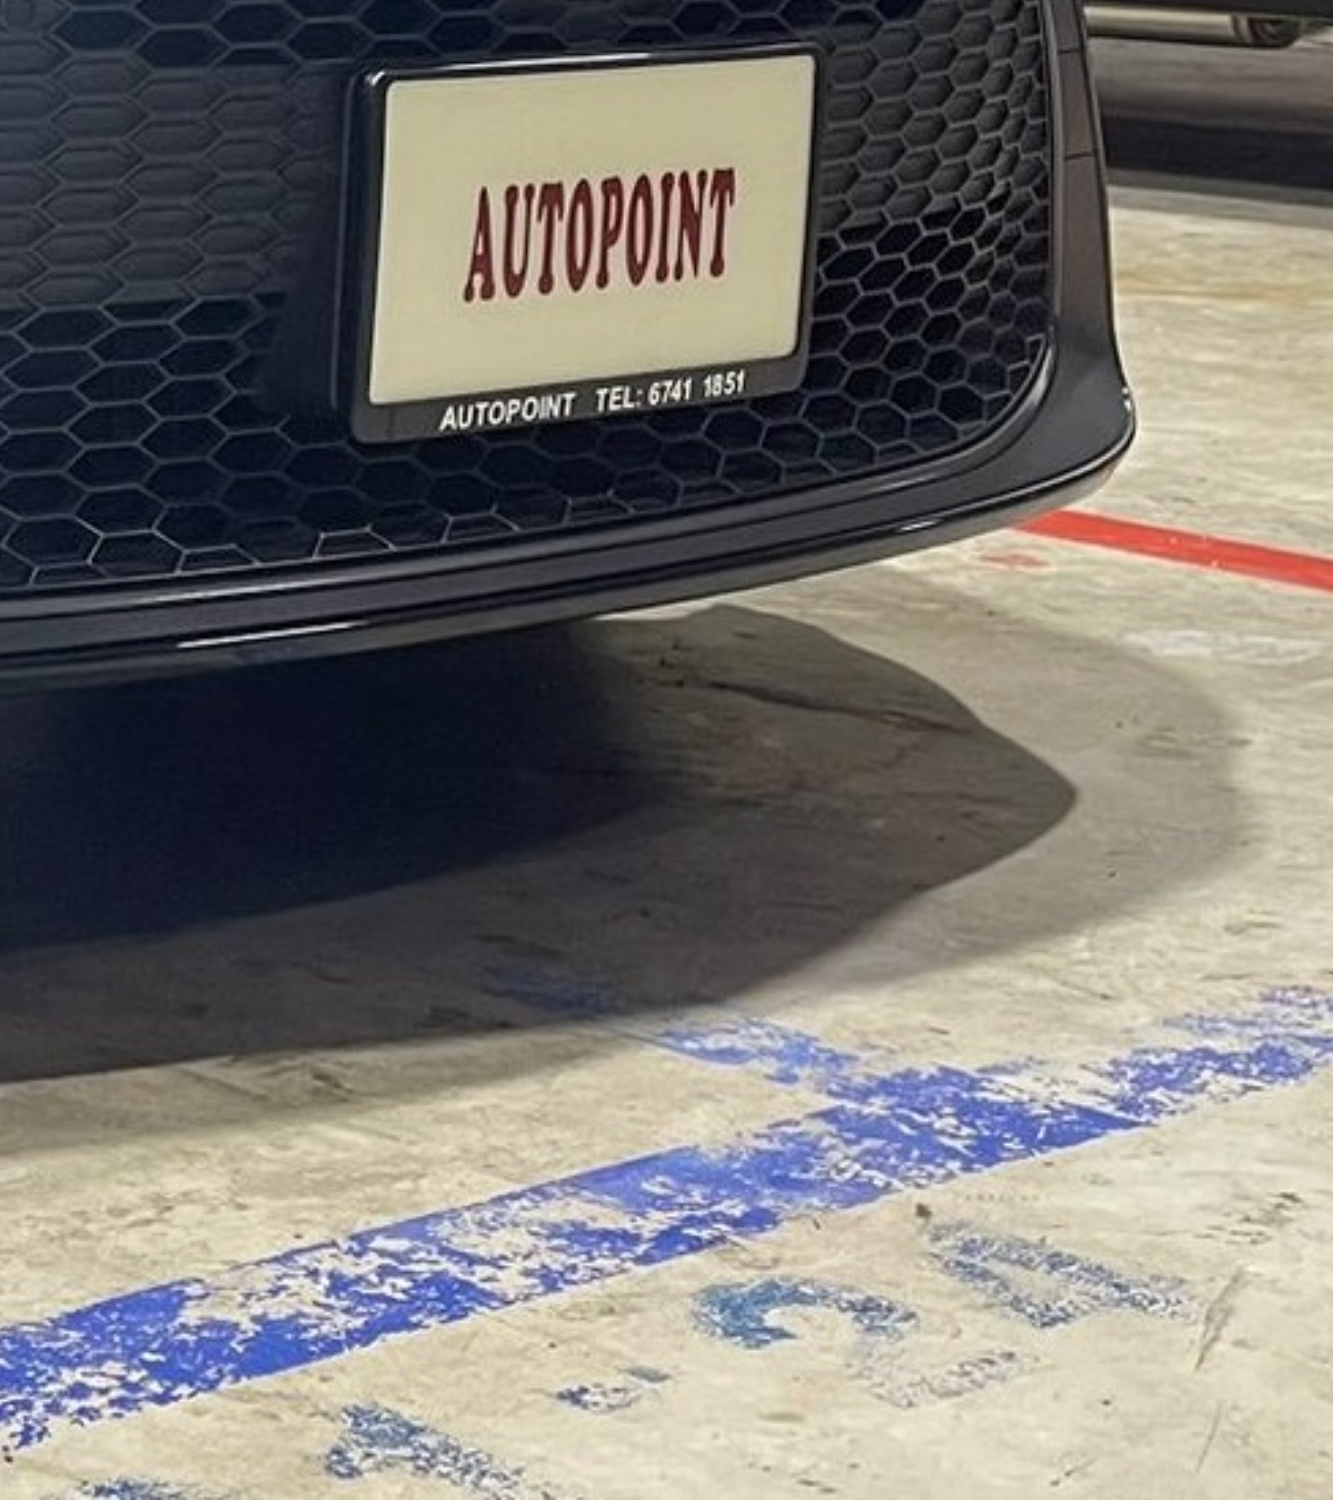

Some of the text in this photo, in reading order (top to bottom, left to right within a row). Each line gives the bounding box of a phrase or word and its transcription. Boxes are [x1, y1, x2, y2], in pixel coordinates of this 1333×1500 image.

[464, 167, 735, 302] AUTOPOINT
[439, 369, 746, 432] AUTOPOINT TEL: 6741 1851
